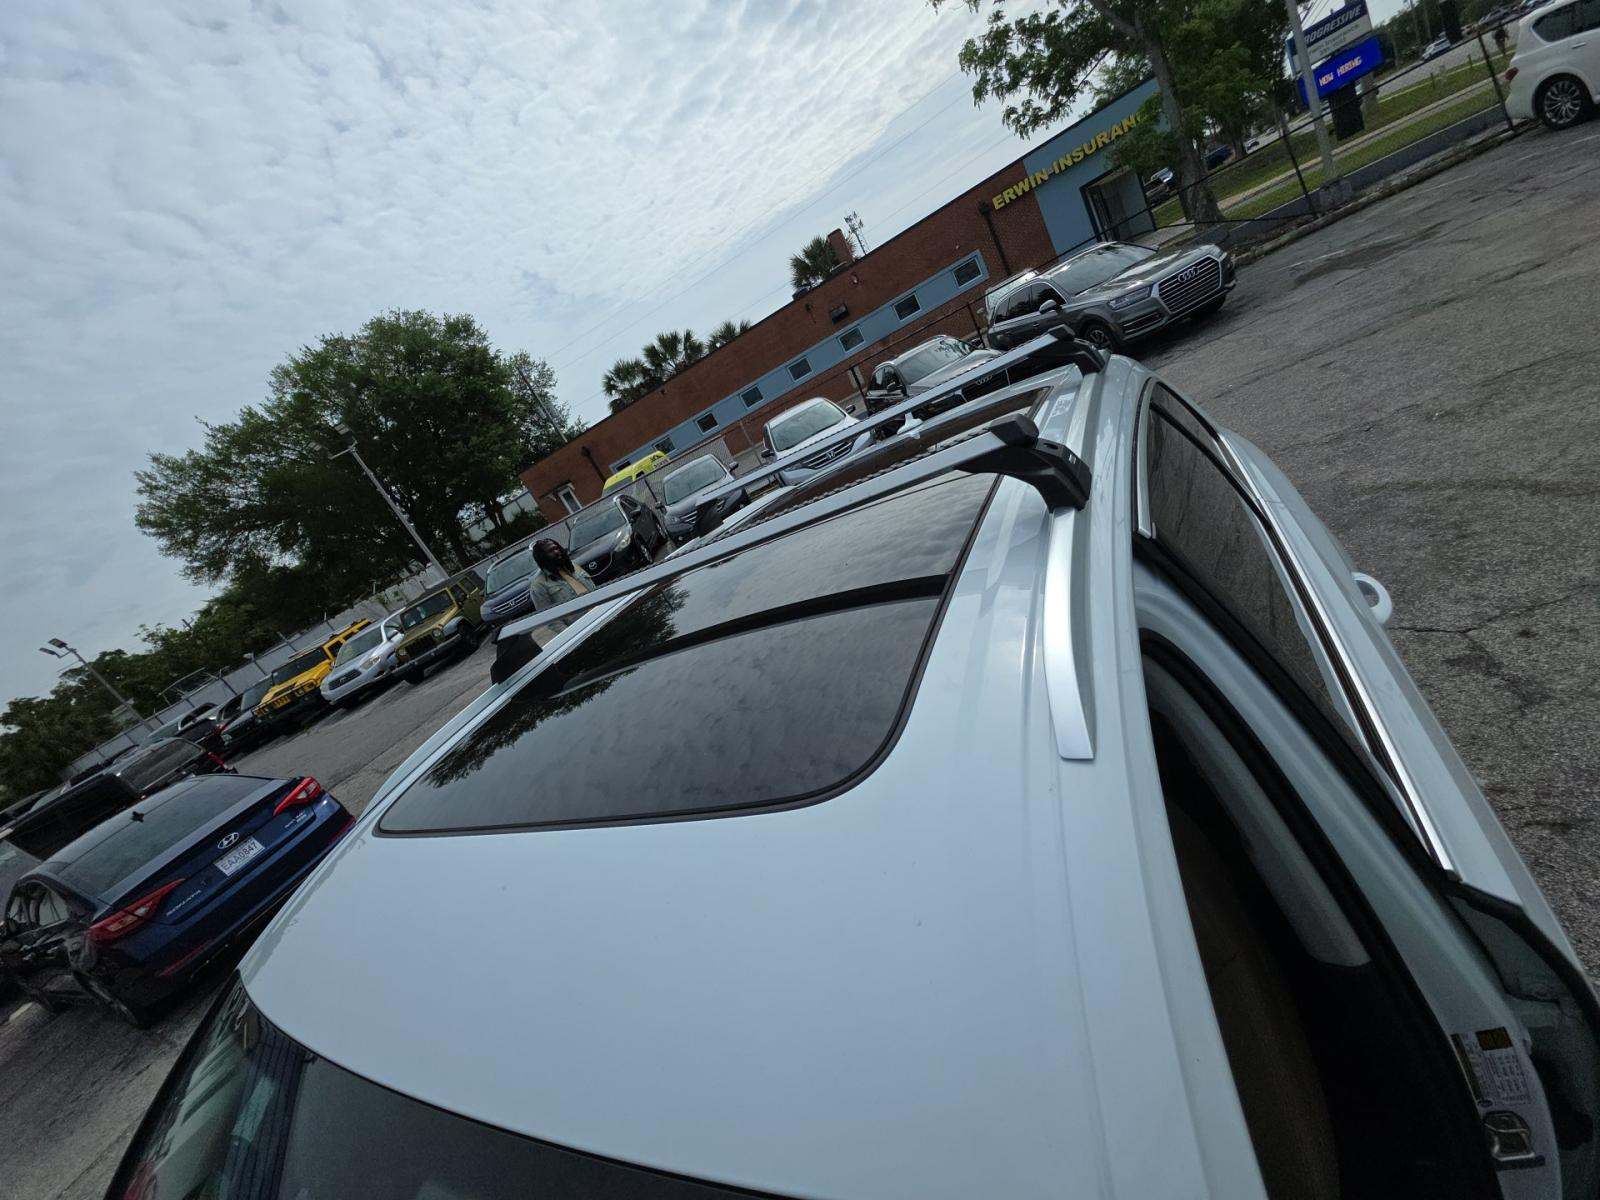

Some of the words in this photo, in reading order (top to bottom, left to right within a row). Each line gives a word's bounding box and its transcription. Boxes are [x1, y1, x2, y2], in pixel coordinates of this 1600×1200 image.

[1304, 4, 1362, 45] ROGRESSIVE
[1319, 72, 1334, 87] NOW
[1337, 55, 1362, 77] HIRING
[992, 167, 1050, 210] ERWIN
[1052, 112, 1142, 174] INSURAN
